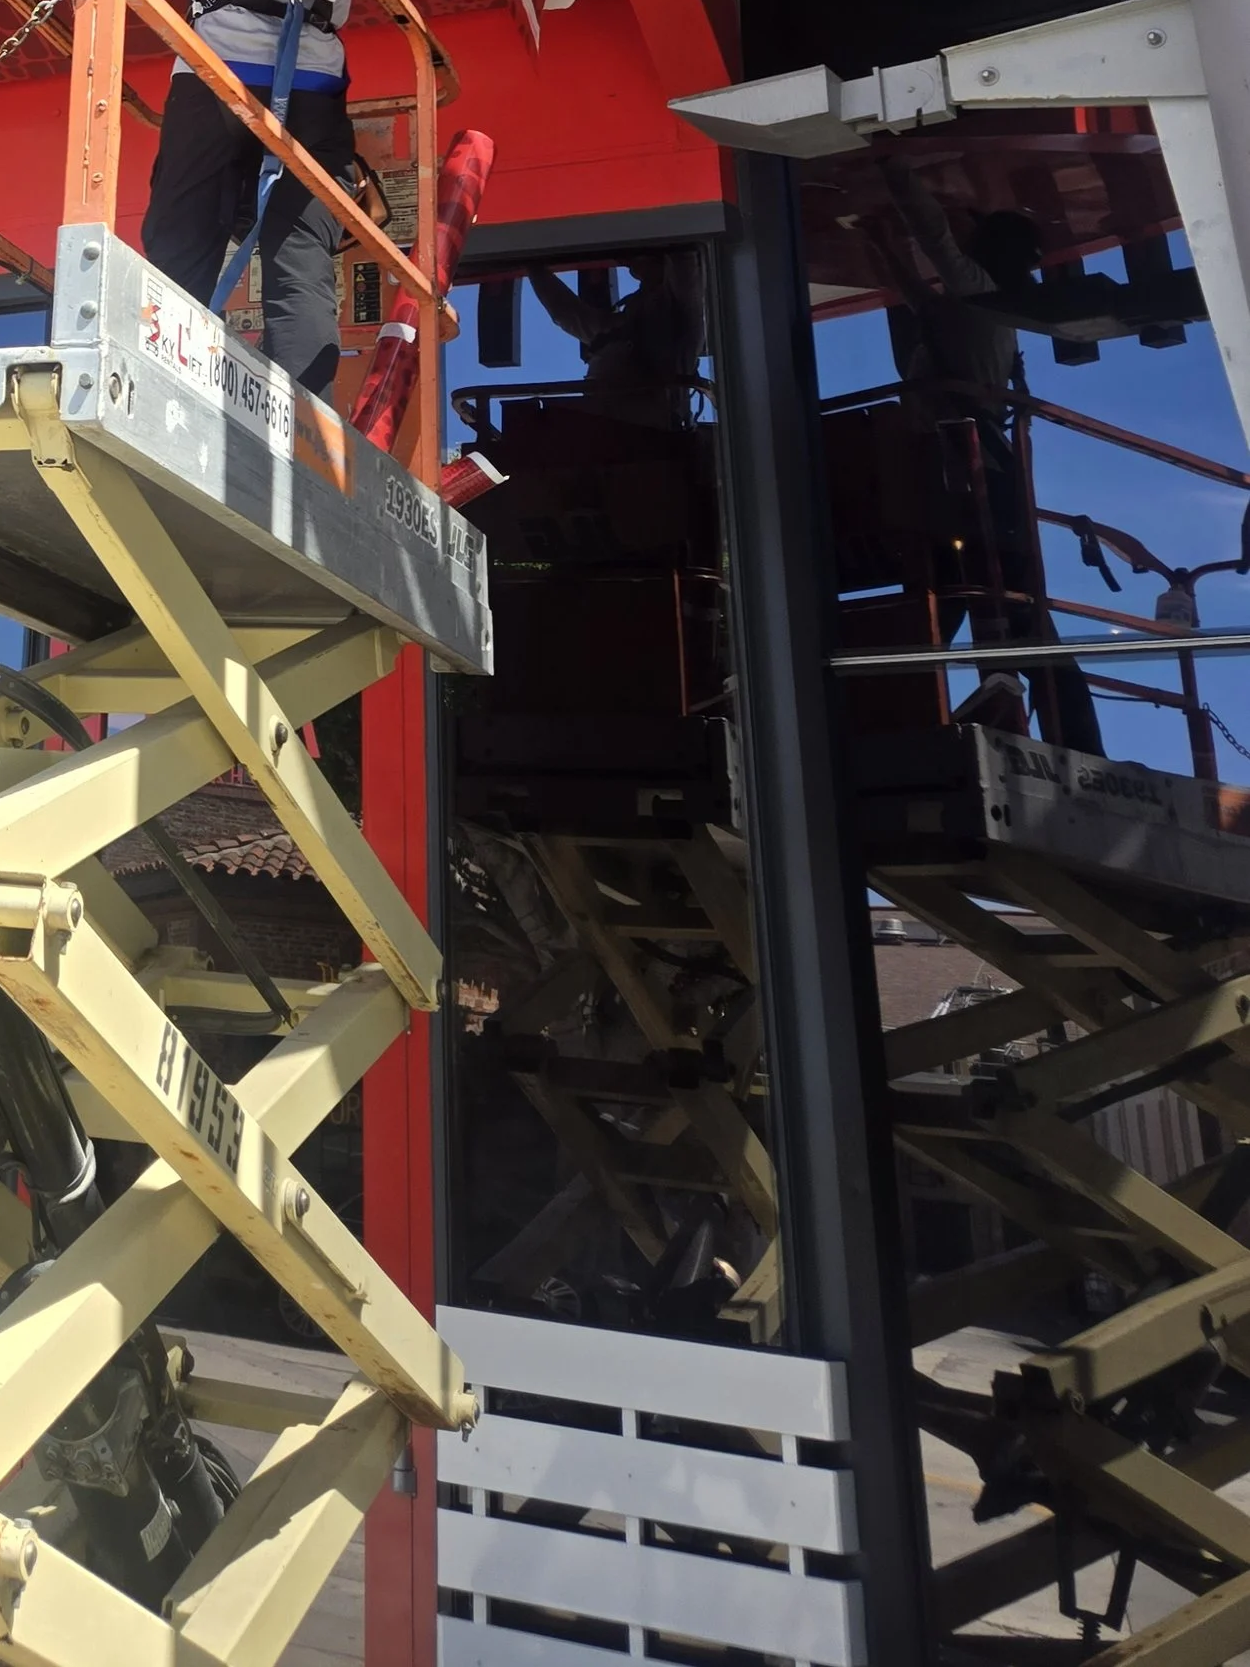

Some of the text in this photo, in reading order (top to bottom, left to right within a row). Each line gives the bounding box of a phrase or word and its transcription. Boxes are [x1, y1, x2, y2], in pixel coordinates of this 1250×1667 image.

[209, 351, 290, 439] (800) 457-6616
[385, 474, 439, 549] 1930ES
